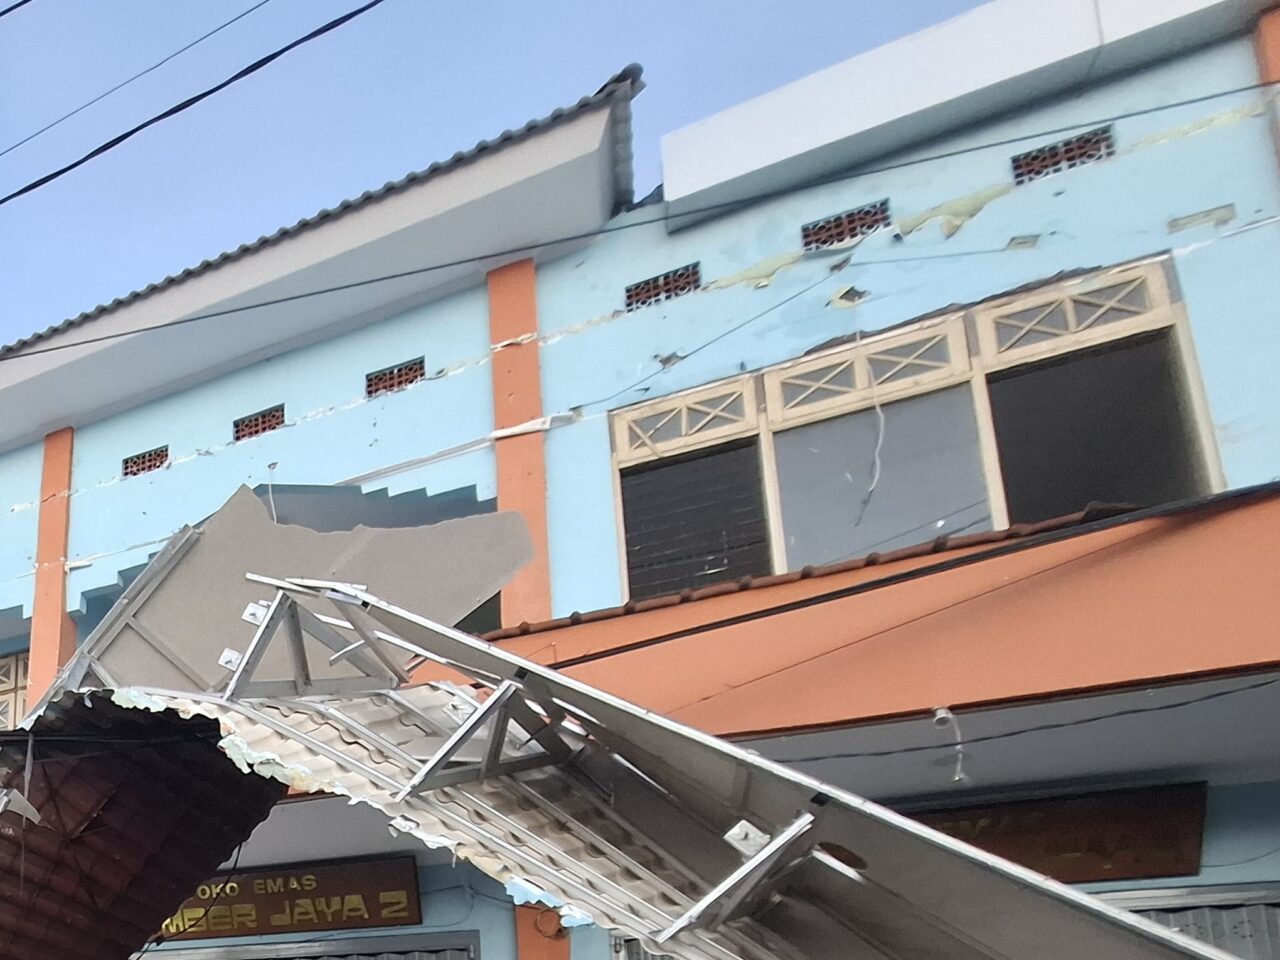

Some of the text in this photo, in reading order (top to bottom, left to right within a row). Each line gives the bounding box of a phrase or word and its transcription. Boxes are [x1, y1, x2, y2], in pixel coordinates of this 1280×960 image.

[196, 874, 318, 900] OKO EMAS
[270, 894, 369, 927] JAYA
[379, 889, 409, 919] 2
